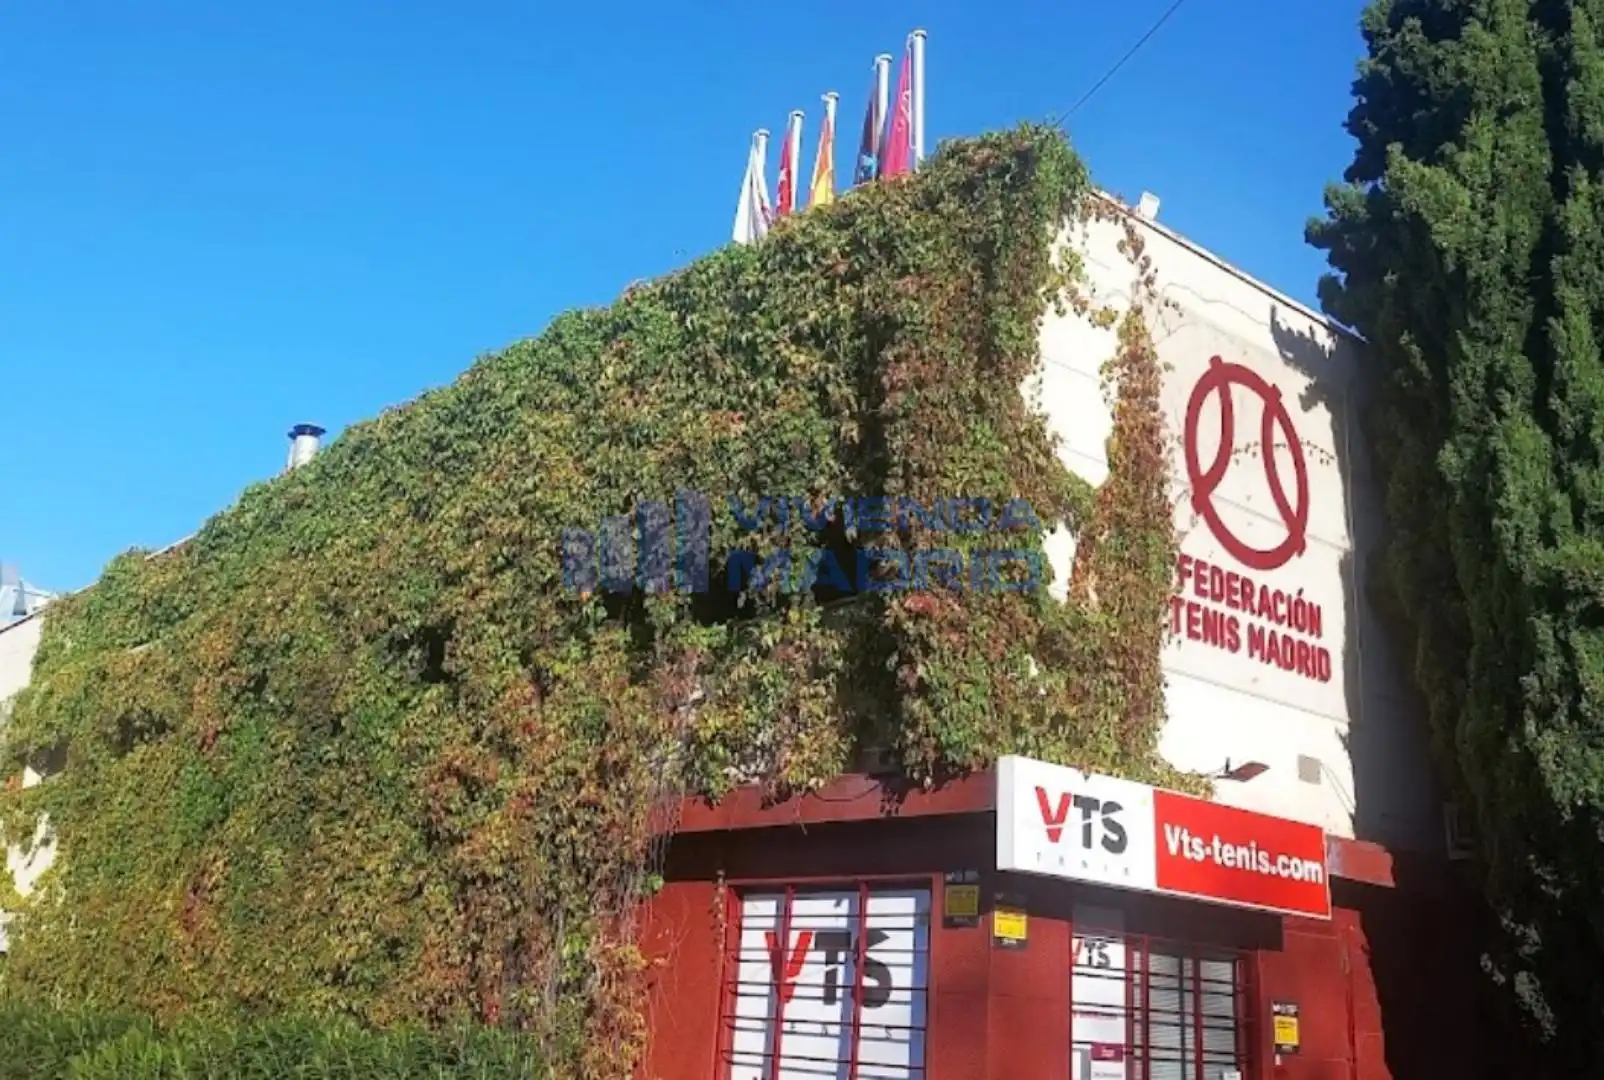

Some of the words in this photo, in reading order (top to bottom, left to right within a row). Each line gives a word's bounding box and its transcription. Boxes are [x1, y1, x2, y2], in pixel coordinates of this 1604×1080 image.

[1178, 553, 1322, 639] FEDERACIÓN
[1169, 595, 1241, 654] TENIS
[1247, 622, 1332, 683] MADRID
[1035, 786, 1128, 854] VTS
[1164, 823, 1324, 885] Vts-tenis.com
[764, 928, 892, 1009] VTS
